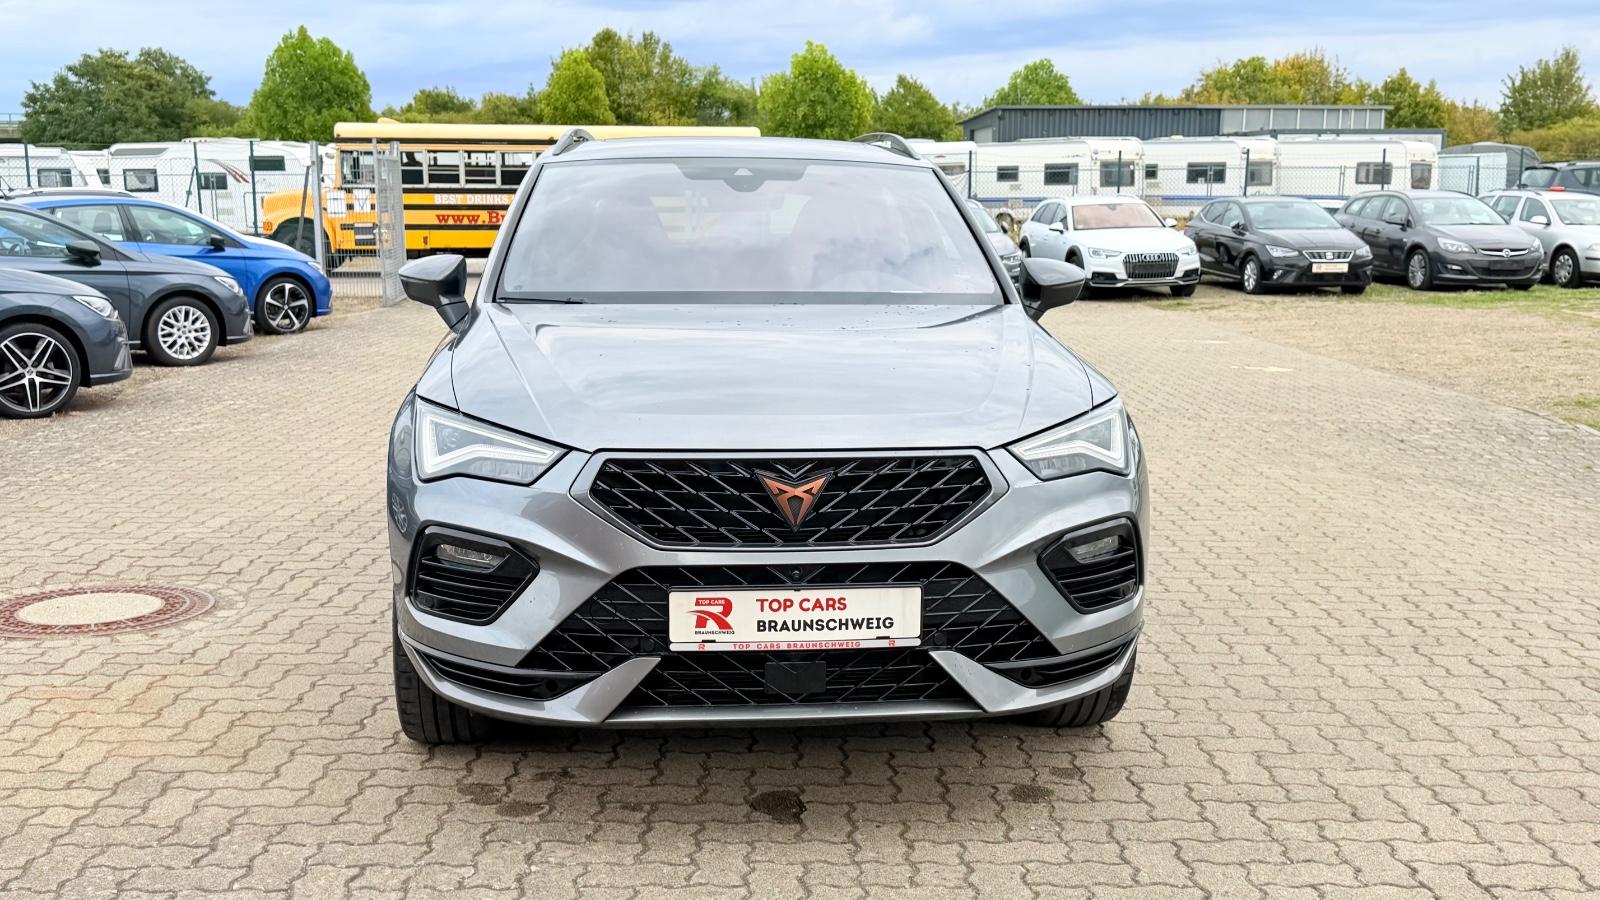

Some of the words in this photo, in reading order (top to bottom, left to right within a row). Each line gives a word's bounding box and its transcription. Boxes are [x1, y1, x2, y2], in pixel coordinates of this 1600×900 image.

[435, 194, 463, 205] BEST
[467, 194, 509, 205] DRINKS
[756, 598, 794, 612] TOP
[798, 597, 847, 612] CARS
[757, 617, 894, 632] BRAUNSCHWEIG
[787, 641, 861, 649] BRAUNSCHWEIG
